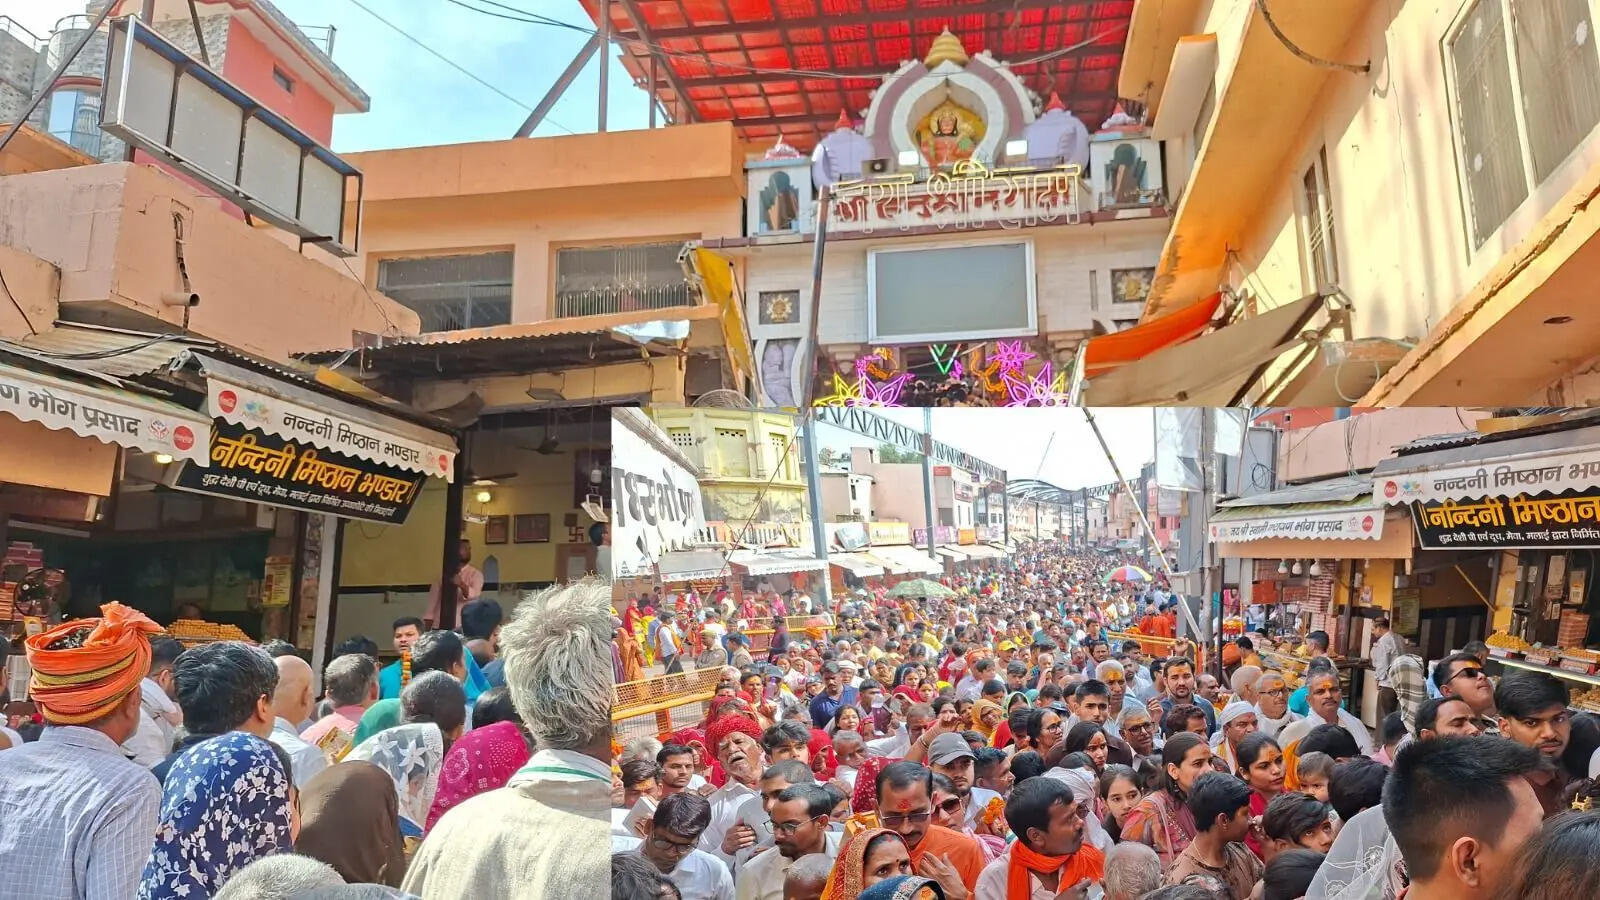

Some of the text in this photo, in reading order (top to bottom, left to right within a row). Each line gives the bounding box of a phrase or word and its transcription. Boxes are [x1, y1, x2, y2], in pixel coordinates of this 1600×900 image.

[926, 159, 988, 230] श्री
[990, 163, 1082, 230] राम
[28, 388, 77, 420] भोग
[82, 405, 141, 437] प्रसाद
[283, 411, 333, 440] नन्दनी
[337, 422, 382, 453] मिष्ठान
[384, 443, 420, 464] भण्डार
[291, 448, 362, 493] मिष्ठान
[1433, 467, 1488, 493] नन्दनी
[1494, 464, 1564, 489] मिष्ठान
[1294, 518, 1314, 532] भोग
[1317, 520, 1343, 534] प्रसाद
[1452, 532, 1467, 542] देशी
[1526, 528, 1550, 541] मलाई
[1551, 530, 1569, 541] द्वारा
